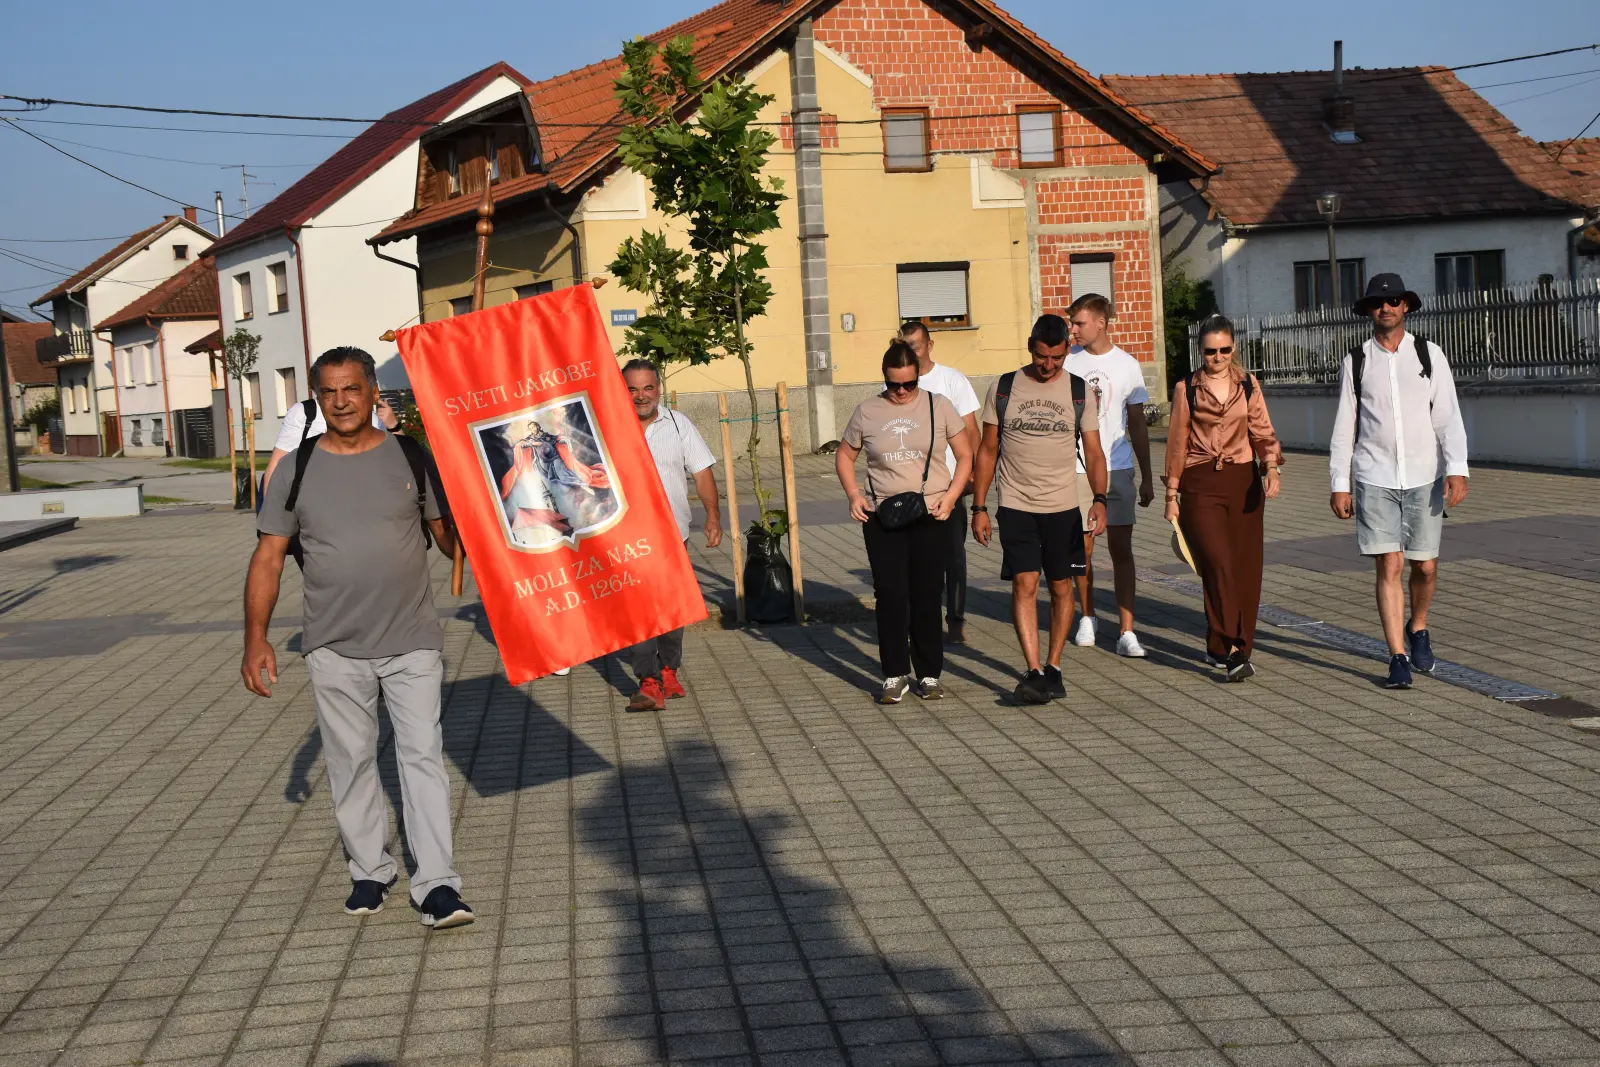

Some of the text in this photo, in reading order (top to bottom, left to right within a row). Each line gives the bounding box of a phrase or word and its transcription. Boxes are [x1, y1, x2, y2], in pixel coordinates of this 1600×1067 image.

[444, 361, 596, 416] SVETI JAKOBE
[1017, 400, 1034, 414] JACK
[1042, 399, 1065, 416] JONES
[1009, 417, 1070, 432] Denim Co.
[883, 450, 924, 462] THE SEA
[514, 538, 652, 599] MOLI ZA NAS
[545, 571, 641, 617] A.D. 1264.
